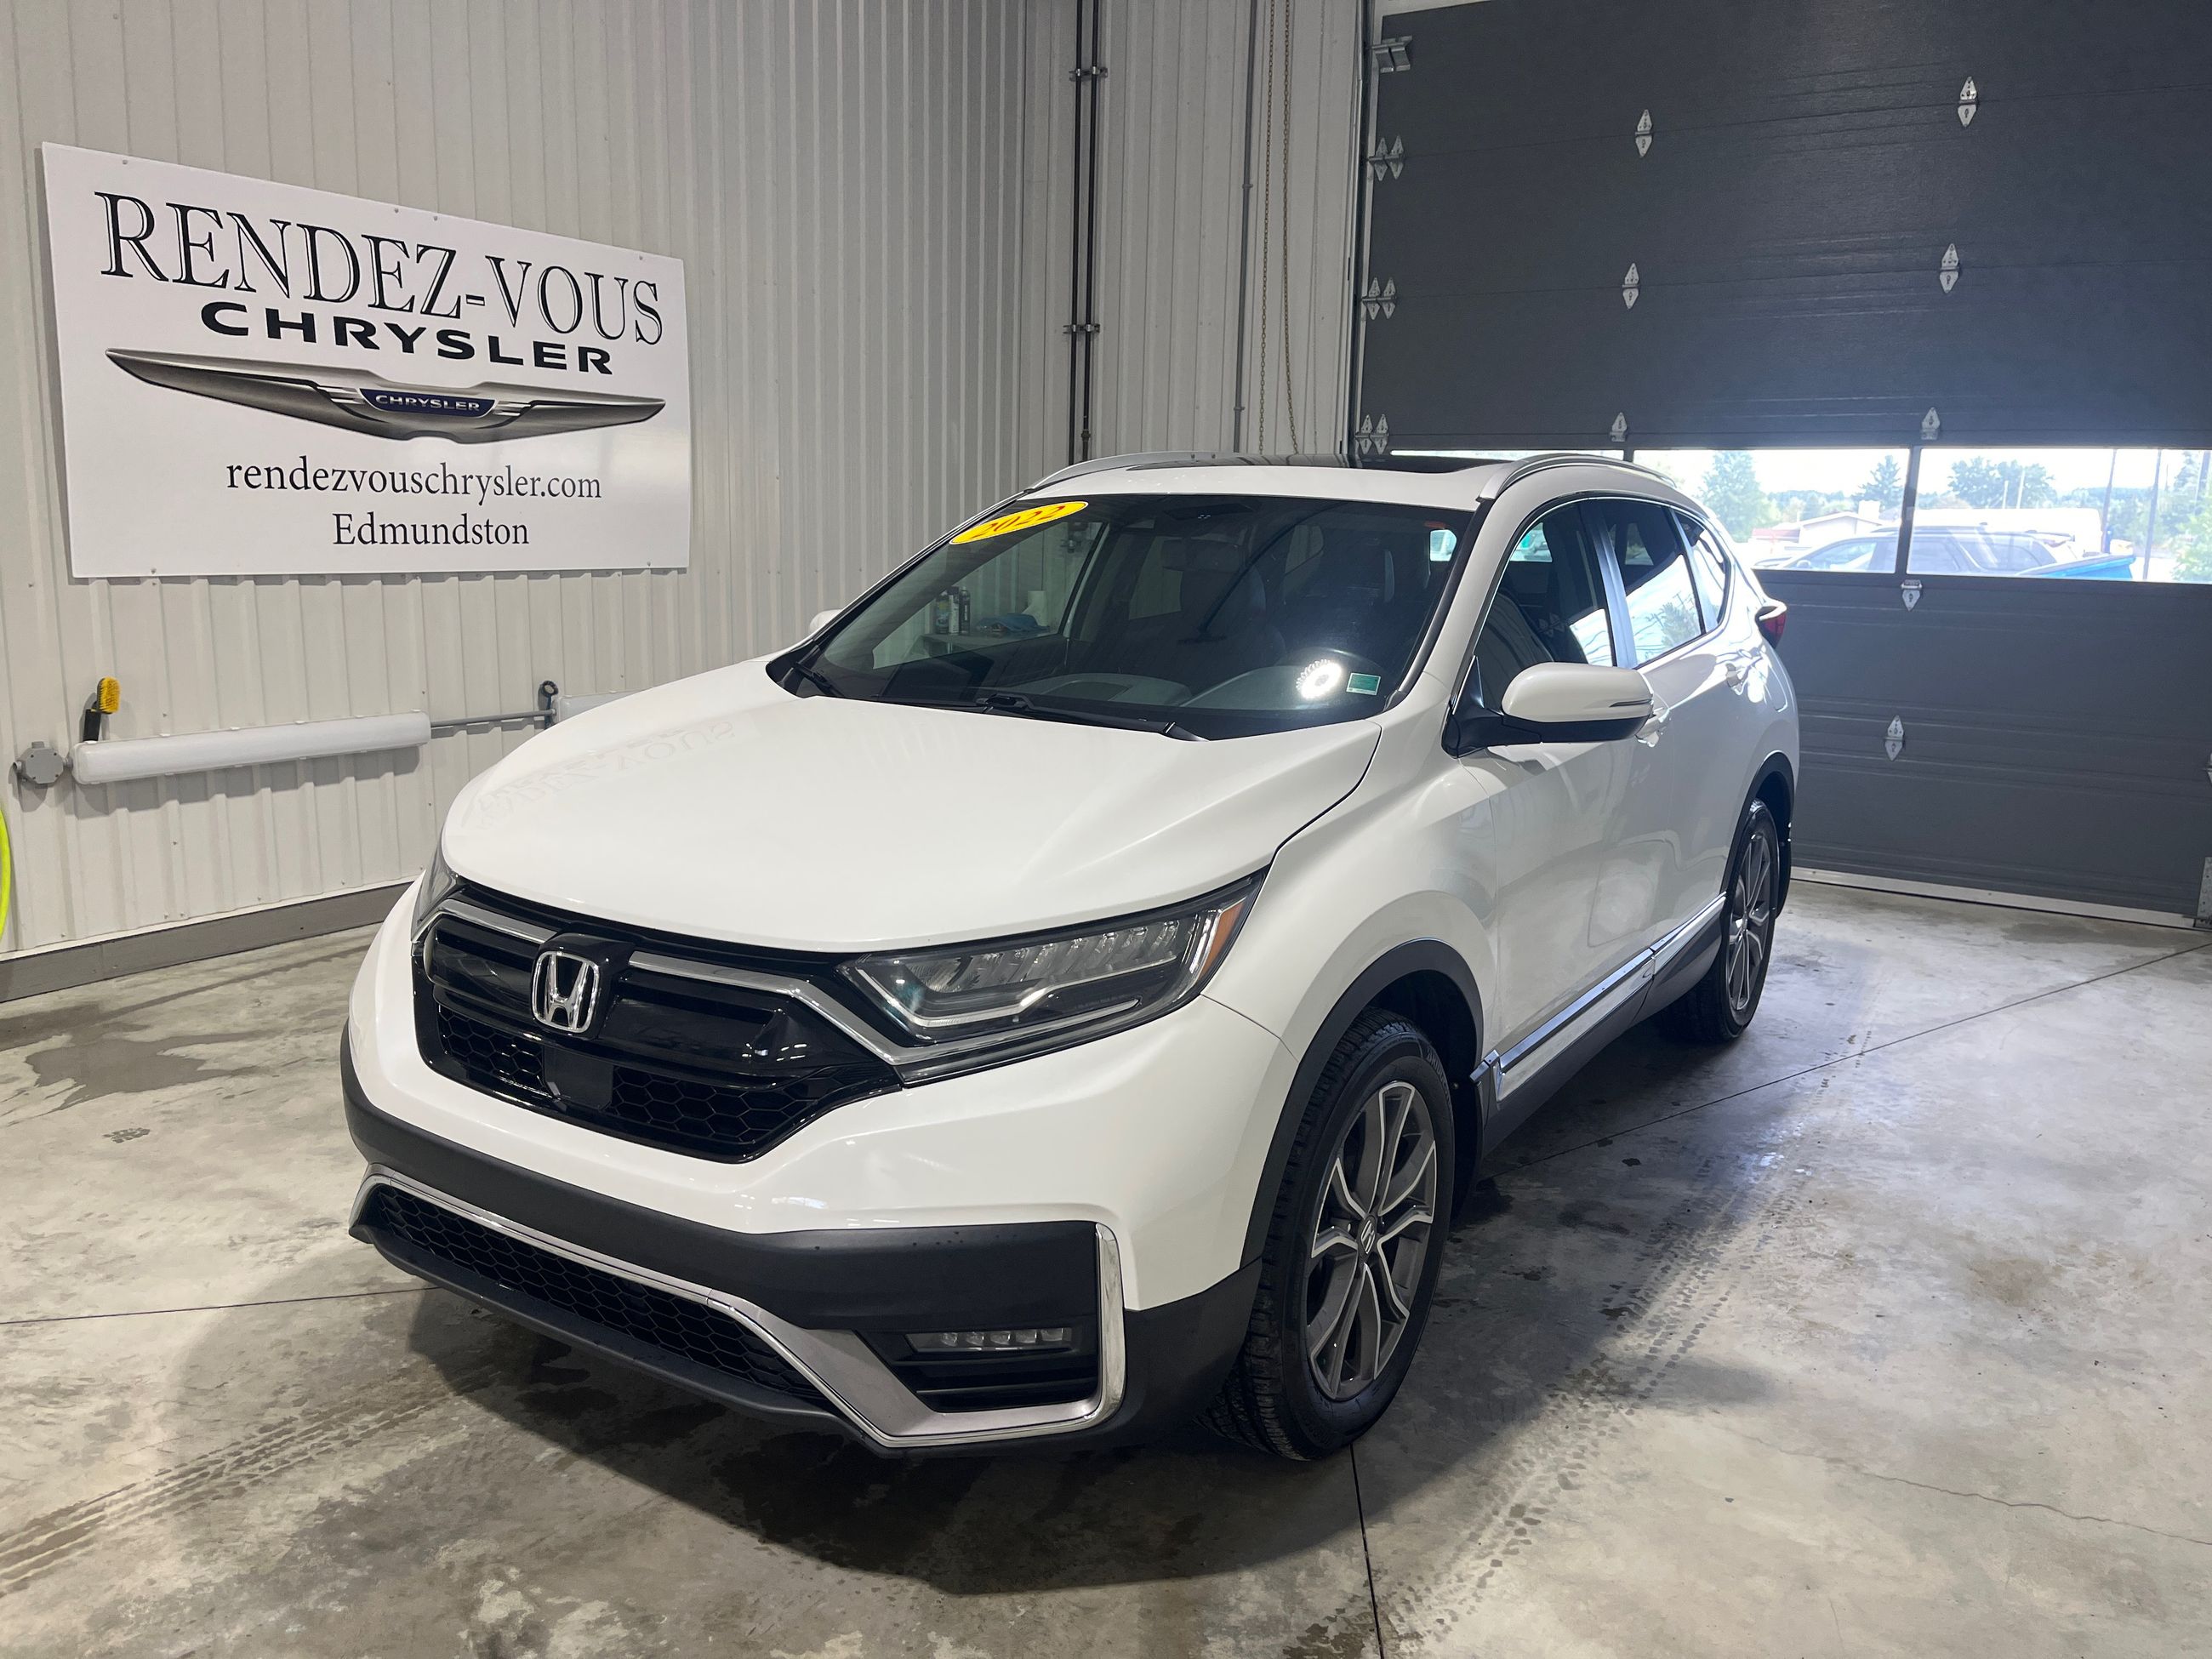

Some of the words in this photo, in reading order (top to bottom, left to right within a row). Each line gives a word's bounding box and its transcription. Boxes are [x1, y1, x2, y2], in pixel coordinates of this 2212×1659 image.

[94, 191, 664, 345] RENDEZ-VOUS
[201, 301, 613, 375] CHRYSLER
[375, 394, 480, 411] CHRYSLER
[226, 456, 601, 506] rendezvouschrysler.com
[333, 511, 529, 545] Edmundston
[970, 505, 1066, 539] 2022
